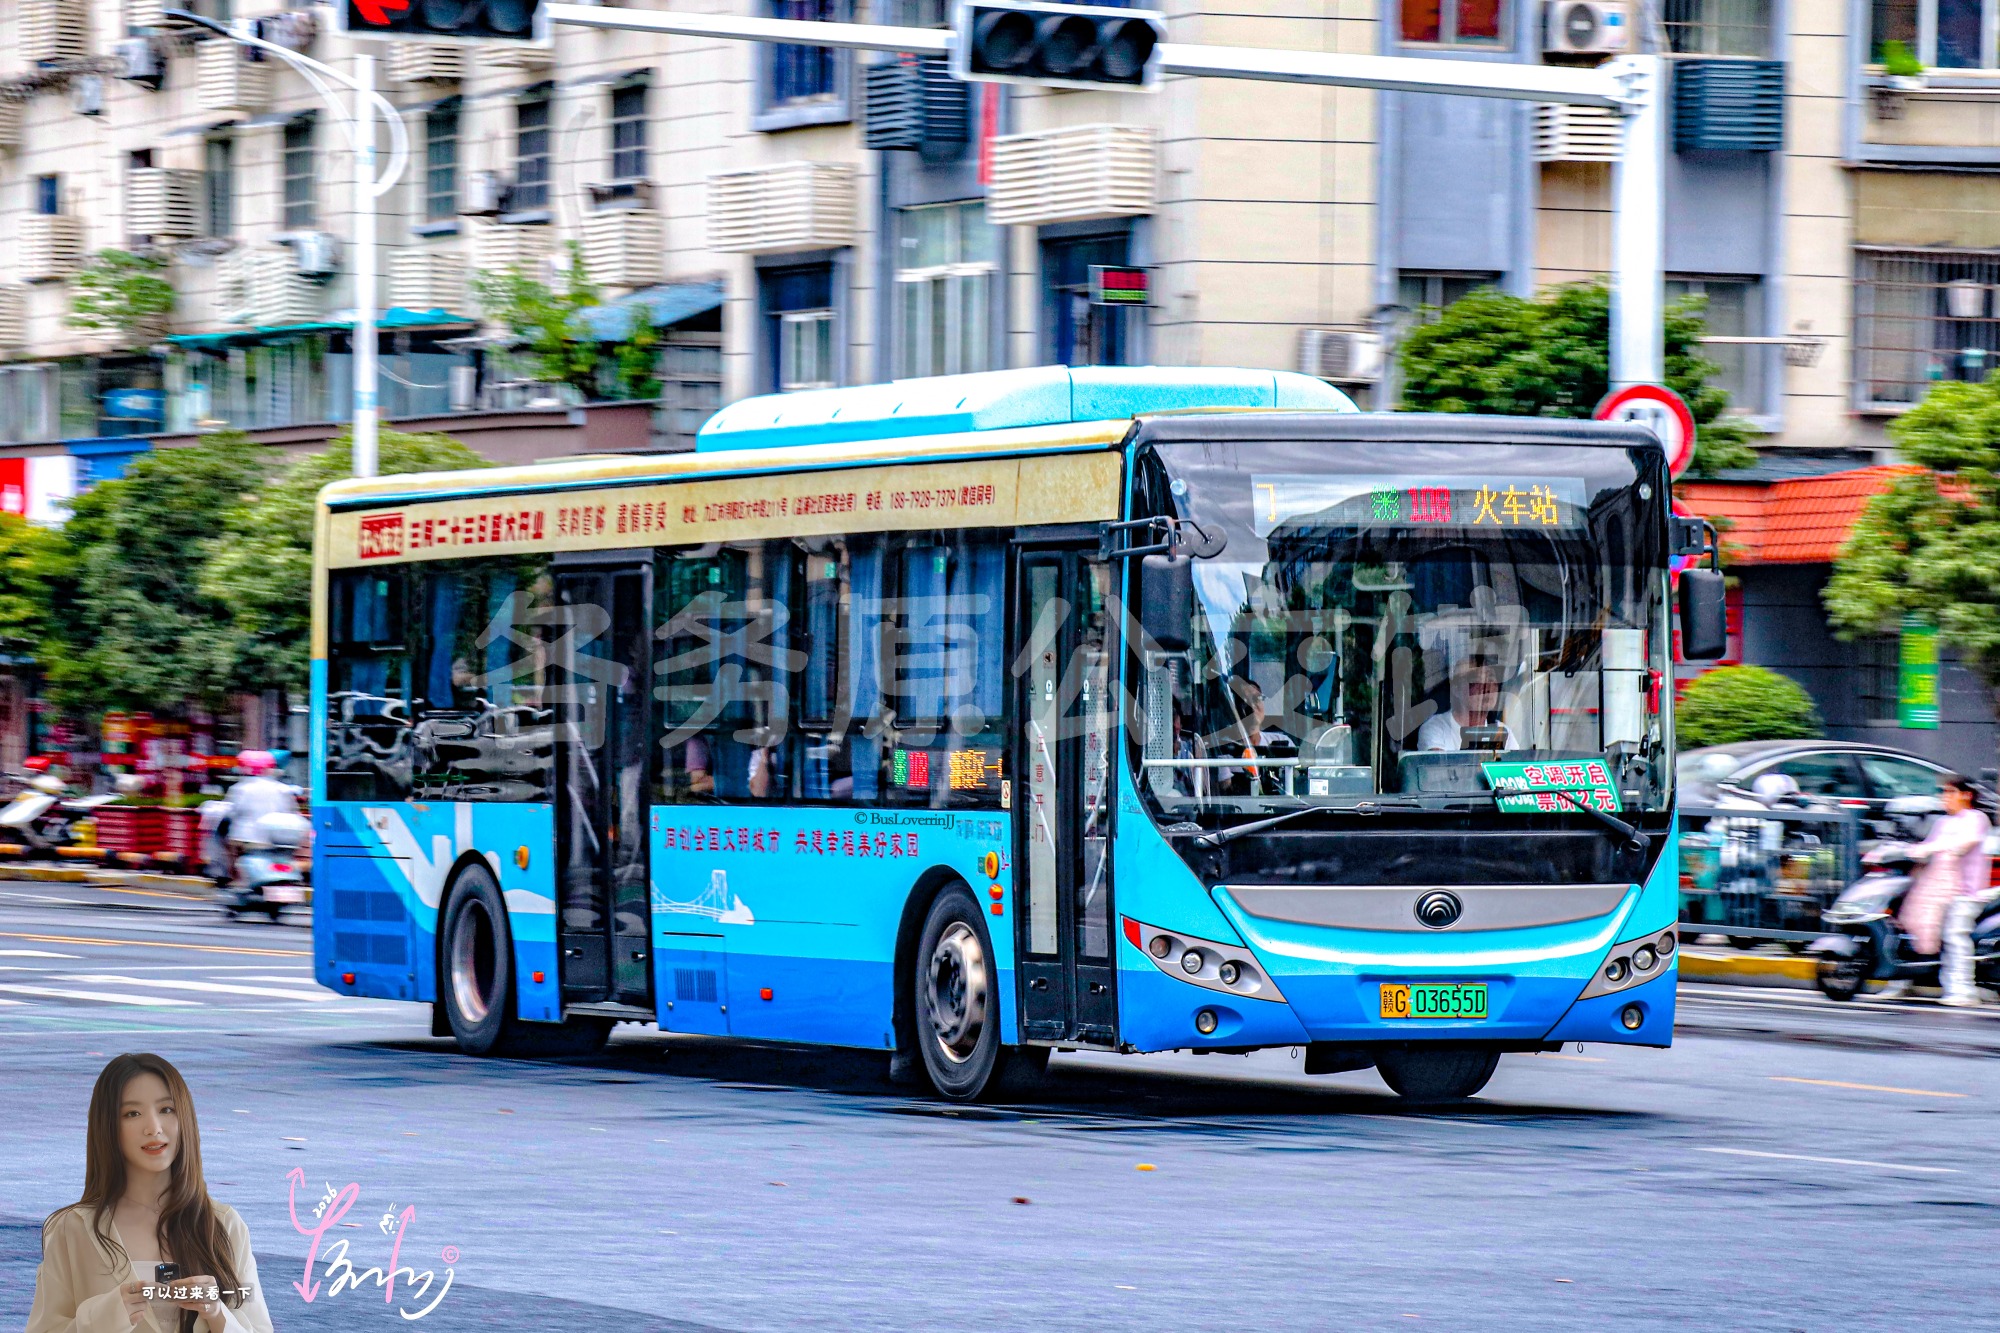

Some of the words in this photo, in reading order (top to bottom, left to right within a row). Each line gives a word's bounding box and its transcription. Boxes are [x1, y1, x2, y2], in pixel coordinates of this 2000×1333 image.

[1407, 485, 1451, 523] 108
[1472, 484, 1558, 525] 火车站
[1523, 763, 1609, 785] 空调开启
[1536, 788, 1616, 812] 票价2元
[795, 828, 919, 858] 共建幸福美好家园
